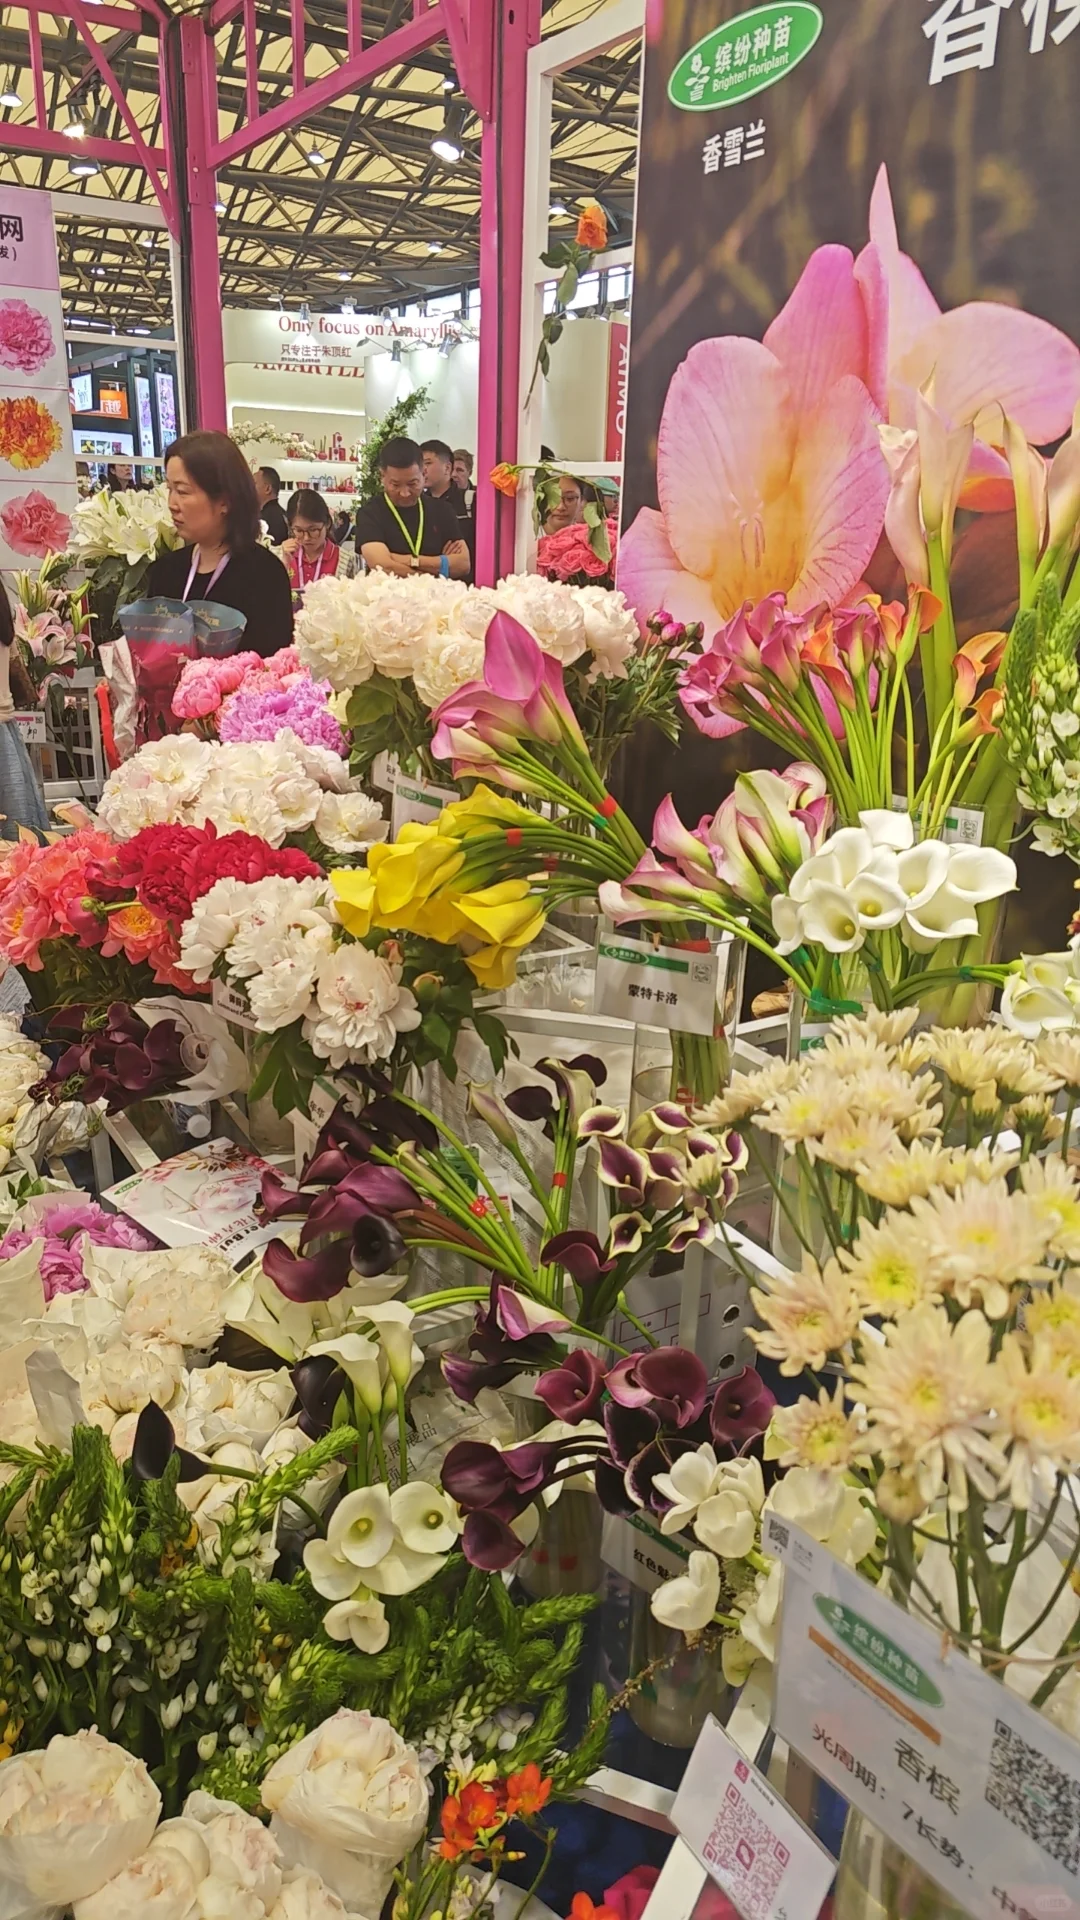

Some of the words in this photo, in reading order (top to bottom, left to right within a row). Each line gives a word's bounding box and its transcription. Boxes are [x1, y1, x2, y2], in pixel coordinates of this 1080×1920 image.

[714, 15, 793, 74] 缤纷种苗
[712, 70, 747, 93] Brighten
[748, 52, 789, 78] Floriplant
[702, 118, 766, 174] 香雪兰
[319, 317, 360, 335] focus
[366, 325, 384, 336] on
[281, 343, 352, 358] 只专注于朱顶红
[628, 983, 678, 1006] 蒙特卡洛
[894, 1738, 960, 1816] 香槟
